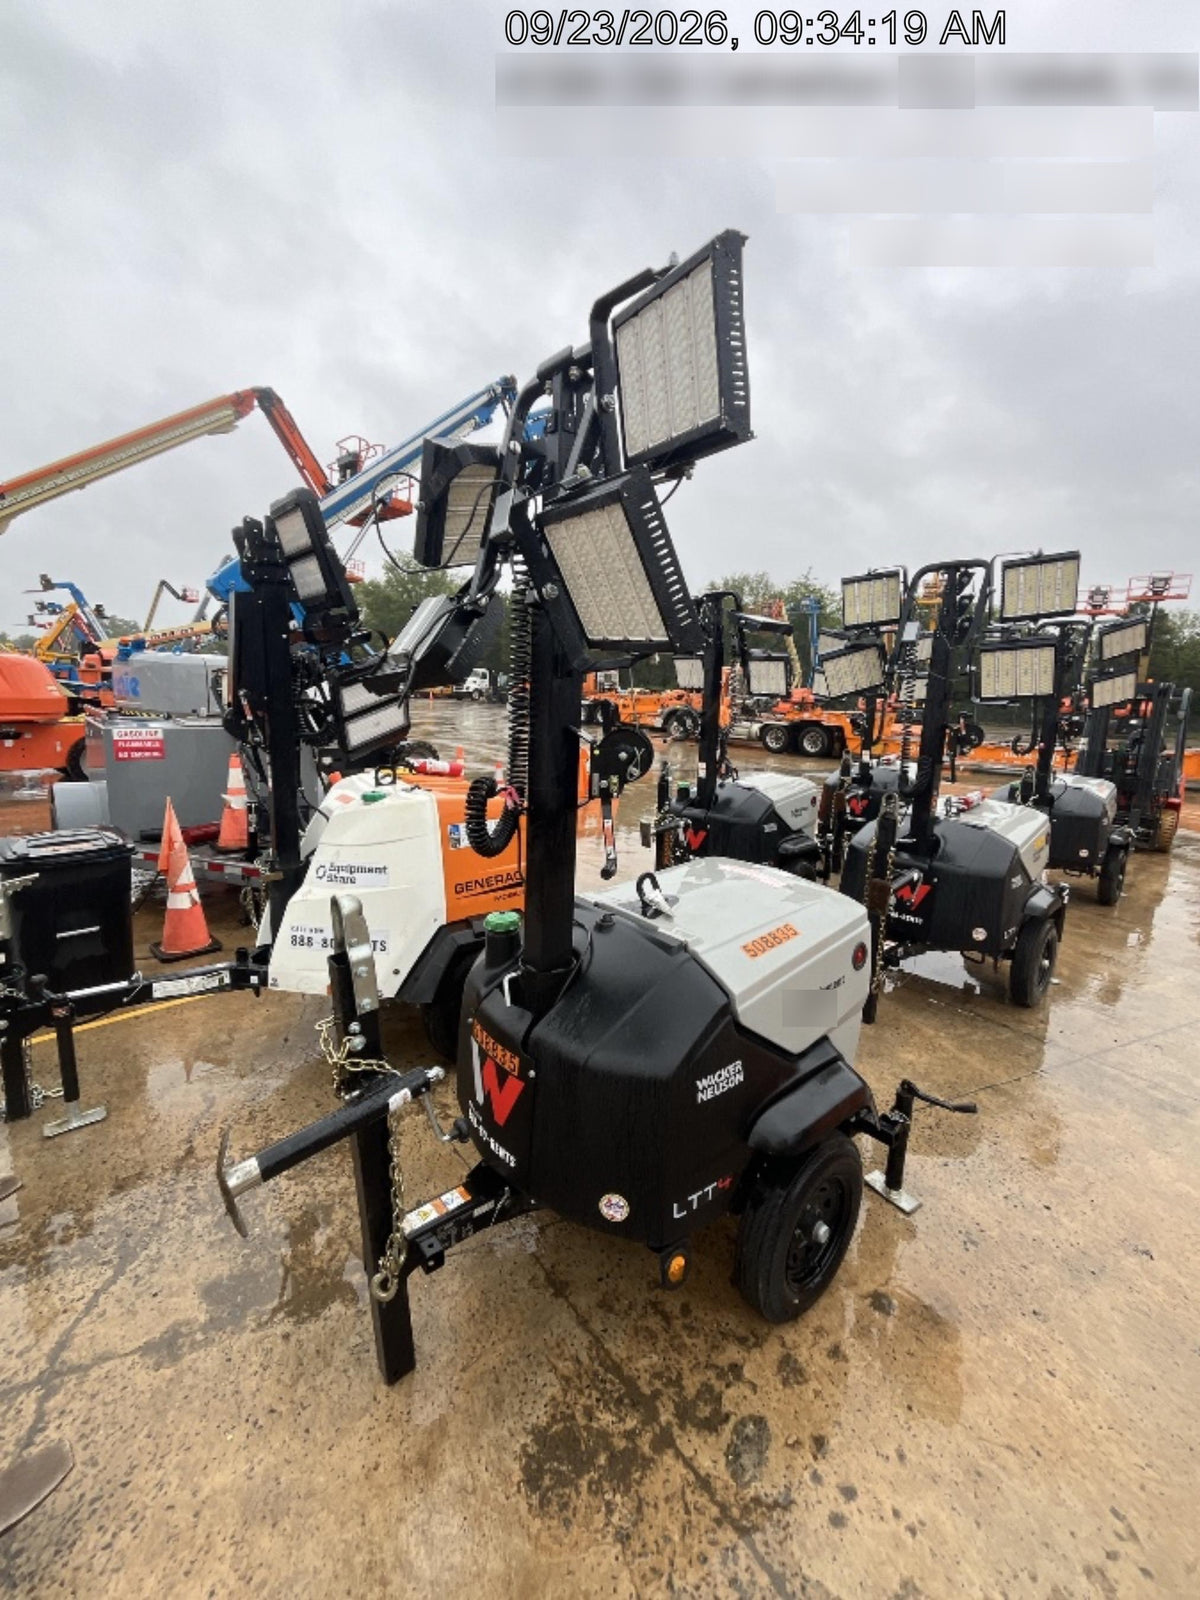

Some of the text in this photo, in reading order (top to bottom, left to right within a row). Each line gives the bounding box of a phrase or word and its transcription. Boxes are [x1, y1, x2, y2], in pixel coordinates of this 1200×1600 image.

[326, 874, 356, 884] Share
[328, 862, 388, 875] Equipment
[454, 870, 522, 895] GENERAC
[742, 923, 800, 958] 508835
[696, 1060, 743, 1091] WACKER
[697, 1071, 745, 1104] NEUSON
[673, 1177, 733, 1219] LTT4
